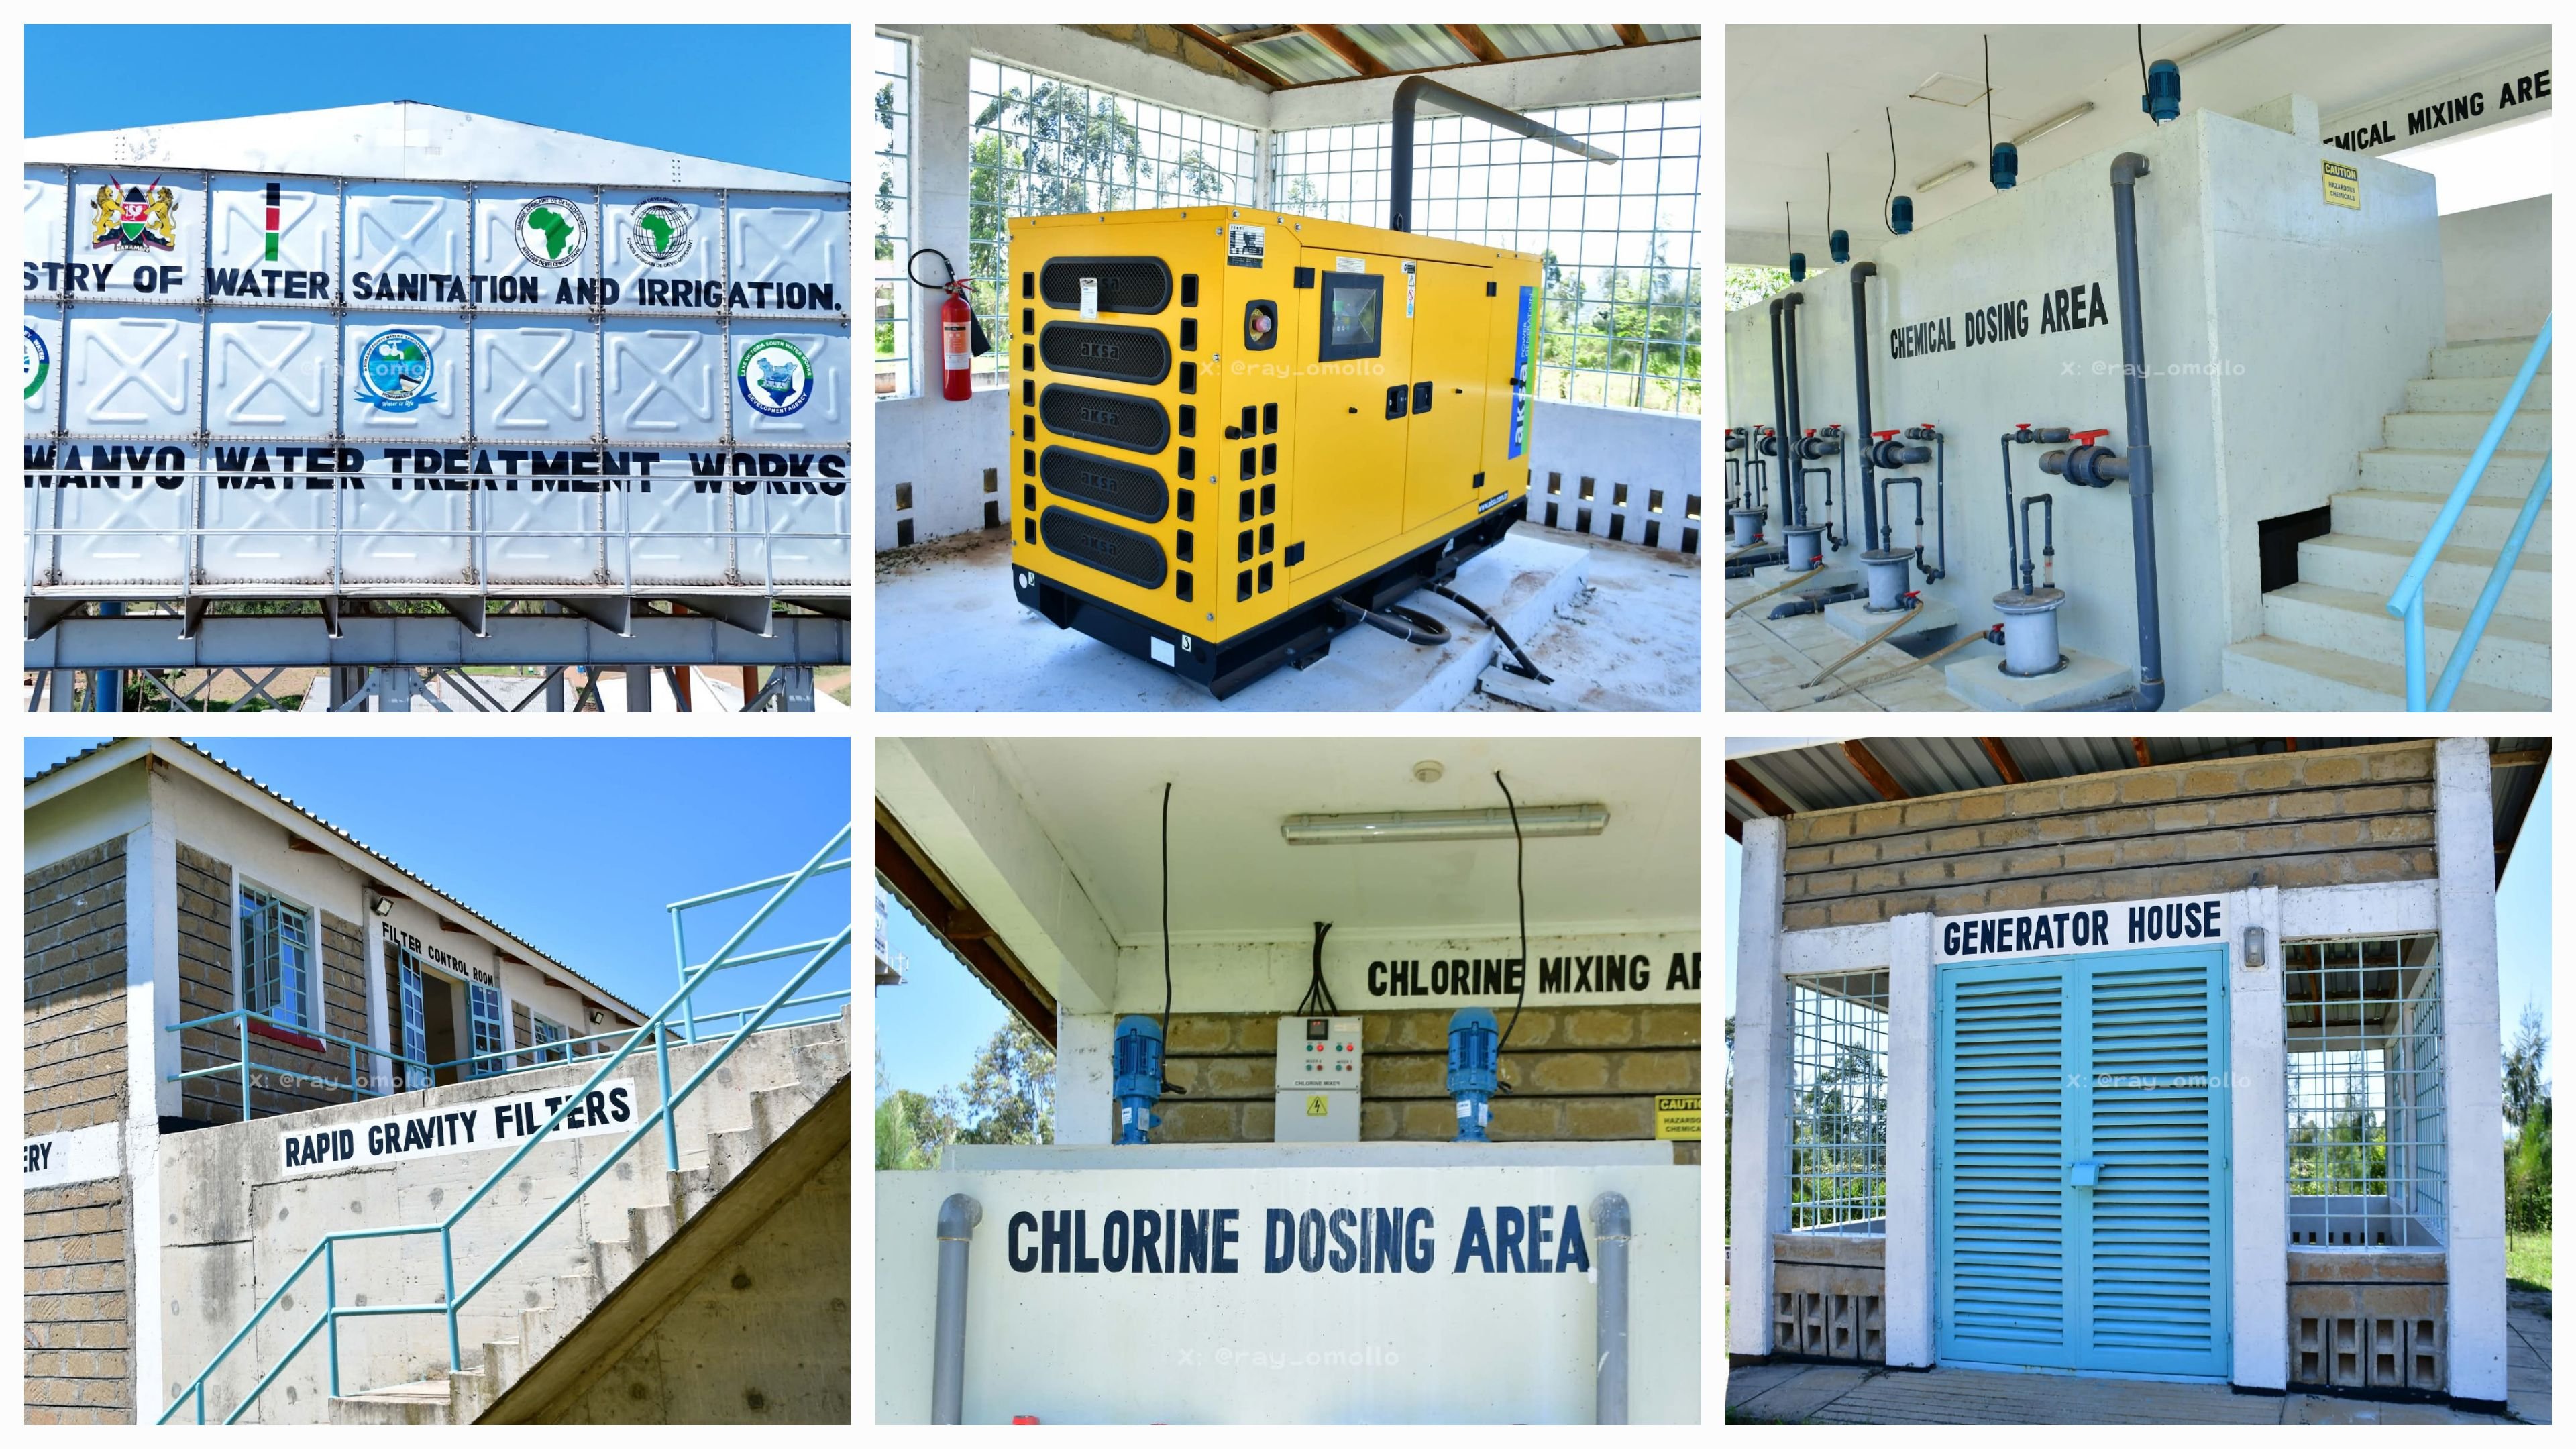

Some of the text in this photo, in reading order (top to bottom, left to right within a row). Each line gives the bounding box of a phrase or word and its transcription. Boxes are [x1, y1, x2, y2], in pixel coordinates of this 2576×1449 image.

[2408, 92, 2484, 136] MIXING
[2499, 70, 2551, 109] ARE
[2325, 164, 2356, 180] CAUTION
[2328, 182, 2355, 193] HAZARDOUS
[2330, 191, 2355, 201] CHEMICALS
[133, 264, 183, 294] OF
[352, 272, 539, 304] SANITATION
[556, 277, 620, 306] AND
[639, 278, 841, 311] IRRIGATION.
[1525, 294, 1533, 357] GENERATION
[1890, 282, 2108, 360] CHEMICAL DOSING AREA
[745, 343, 765, 362] VICTORIA
[785, 343, 802, 356] WATER
[802, 356, 812, 376] WORKS
[1082, 343, 1118, 359] aksa
[747, 393, 808, 413] DEVELOPMENT AGENCY
[1081, 408, 1118, 426] aksa
[1515, 363, 1527, 444] aksa
[215, 446, 365, 490] WATER
[384, 447, 660, 493] TREATMENT
[689, 452, 847, 496] WORKS
[1944, 900, 2221, 956] GENERATOR HOUSE
[382, 922, 494, 987] FILTER CONTROL ROOM
[1368, 959, 1524, 996] CHLORINE
[1539, 954, 1650, 994] MIXING
[286, 1087, 631, 1167] RAPID GRAVITY FILTERS
[1007, 1204, 1591, 1274] CHLORINE DOSING AREA
